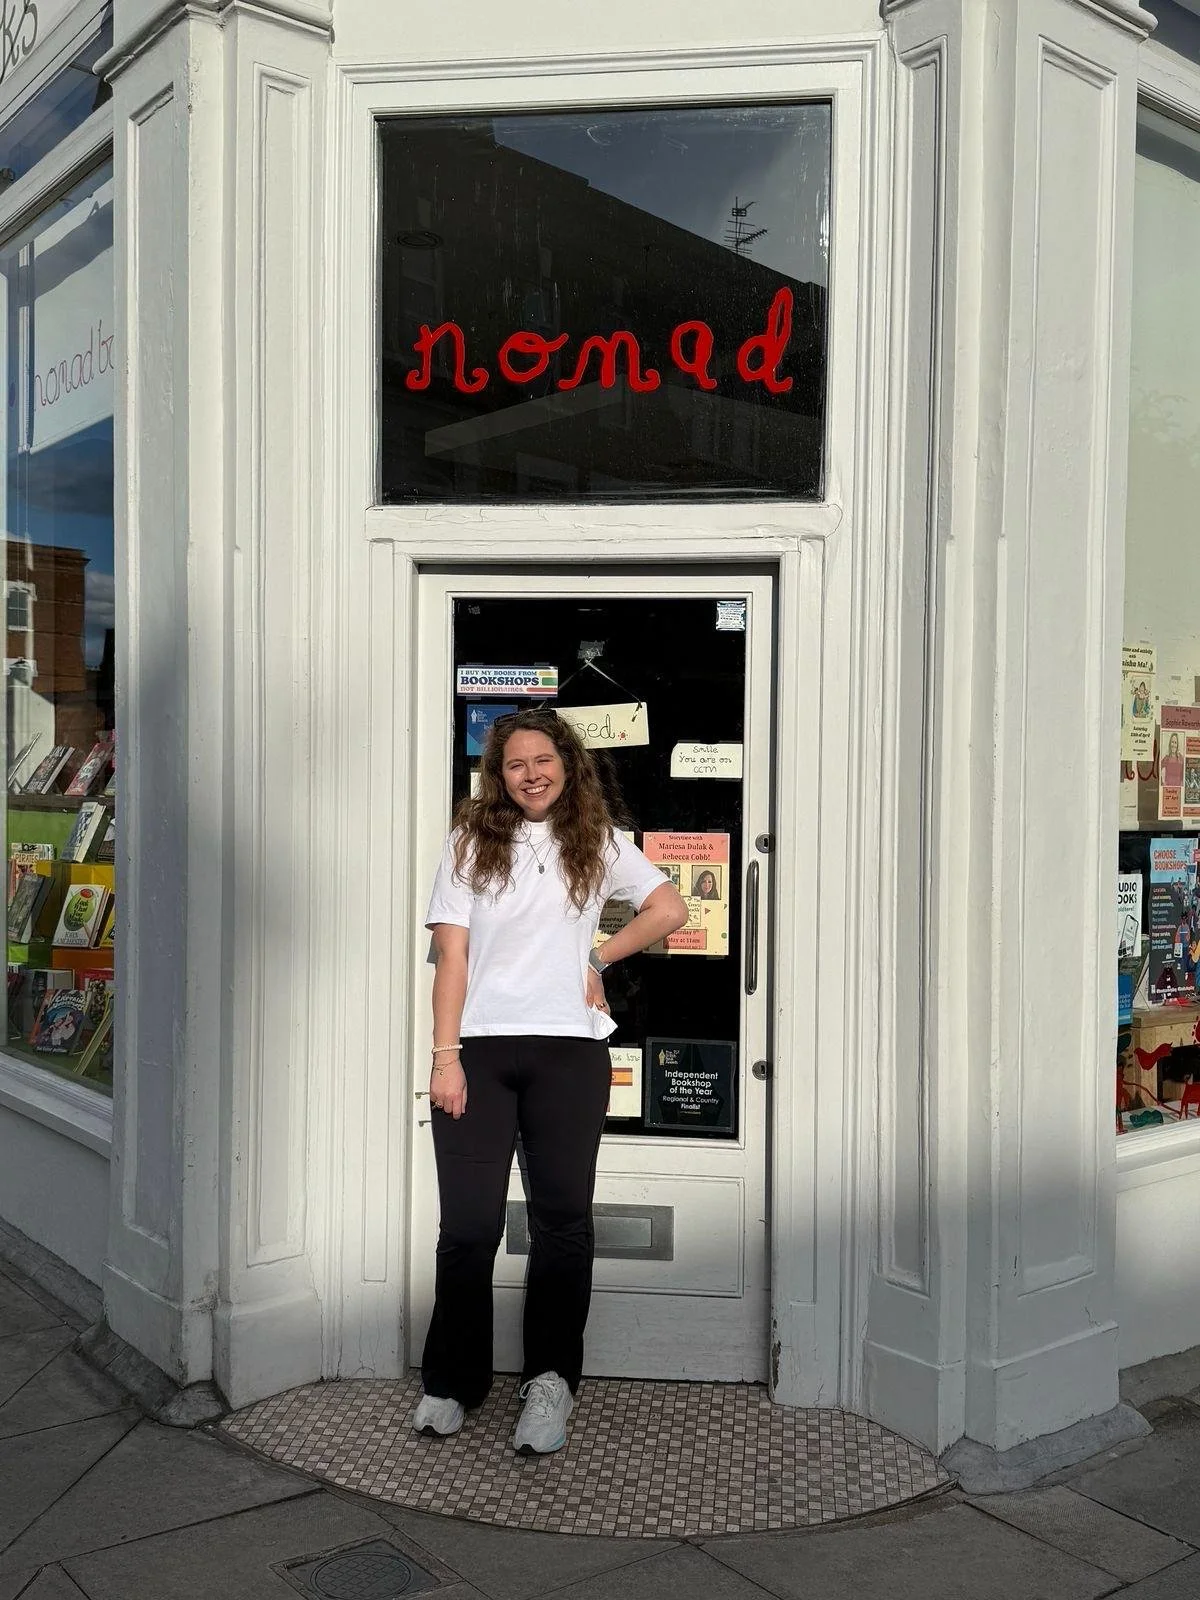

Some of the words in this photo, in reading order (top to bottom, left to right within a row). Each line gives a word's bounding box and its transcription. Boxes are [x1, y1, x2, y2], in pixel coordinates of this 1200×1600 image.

[406, 286, 794, 393] nomad
[35, 326, 94, 406] nomad
[460, 676, 539, 686] BOOKSHOPS
[572, 713, 616, 741] sed
[662, 853, 689, 861] Rebecca
[1153, 849, 1177, 860] CHOOSE
[1154, 860, 1188, 871] BOOKSHOPS
[1118, 881, 1137, 893] UDIO
[1118, 893, 1137, 904] OOKS
[665, 1070, 718, 1080] Independent
[671, 1078, 712, 1088] Bookshop
[679, 1087, 692, 1095] the
[694, 1088, 713, 1096] Year
[662, 1095, 688, 1103] Regional
[695, 1097, 719, 1105] Country
